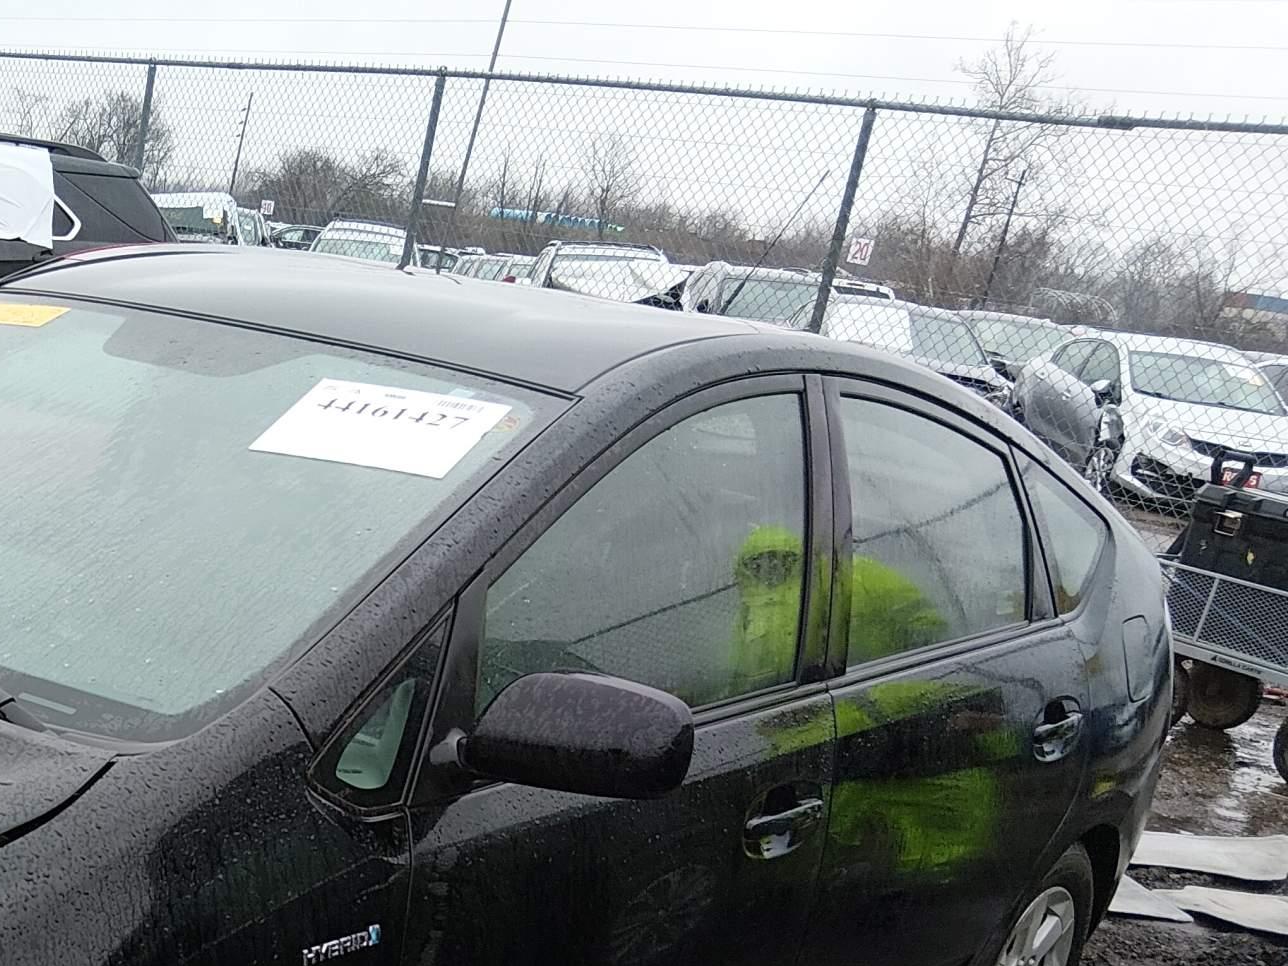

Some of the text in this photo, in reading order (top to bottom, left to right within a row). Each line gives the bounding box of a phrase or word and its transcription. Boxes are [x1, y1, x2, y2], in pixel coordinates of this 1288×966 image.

[852, 241, 870, 261] 20
[317, 397, 470, 429] 44161427
[302, 931, 369, 966] HYBRID
